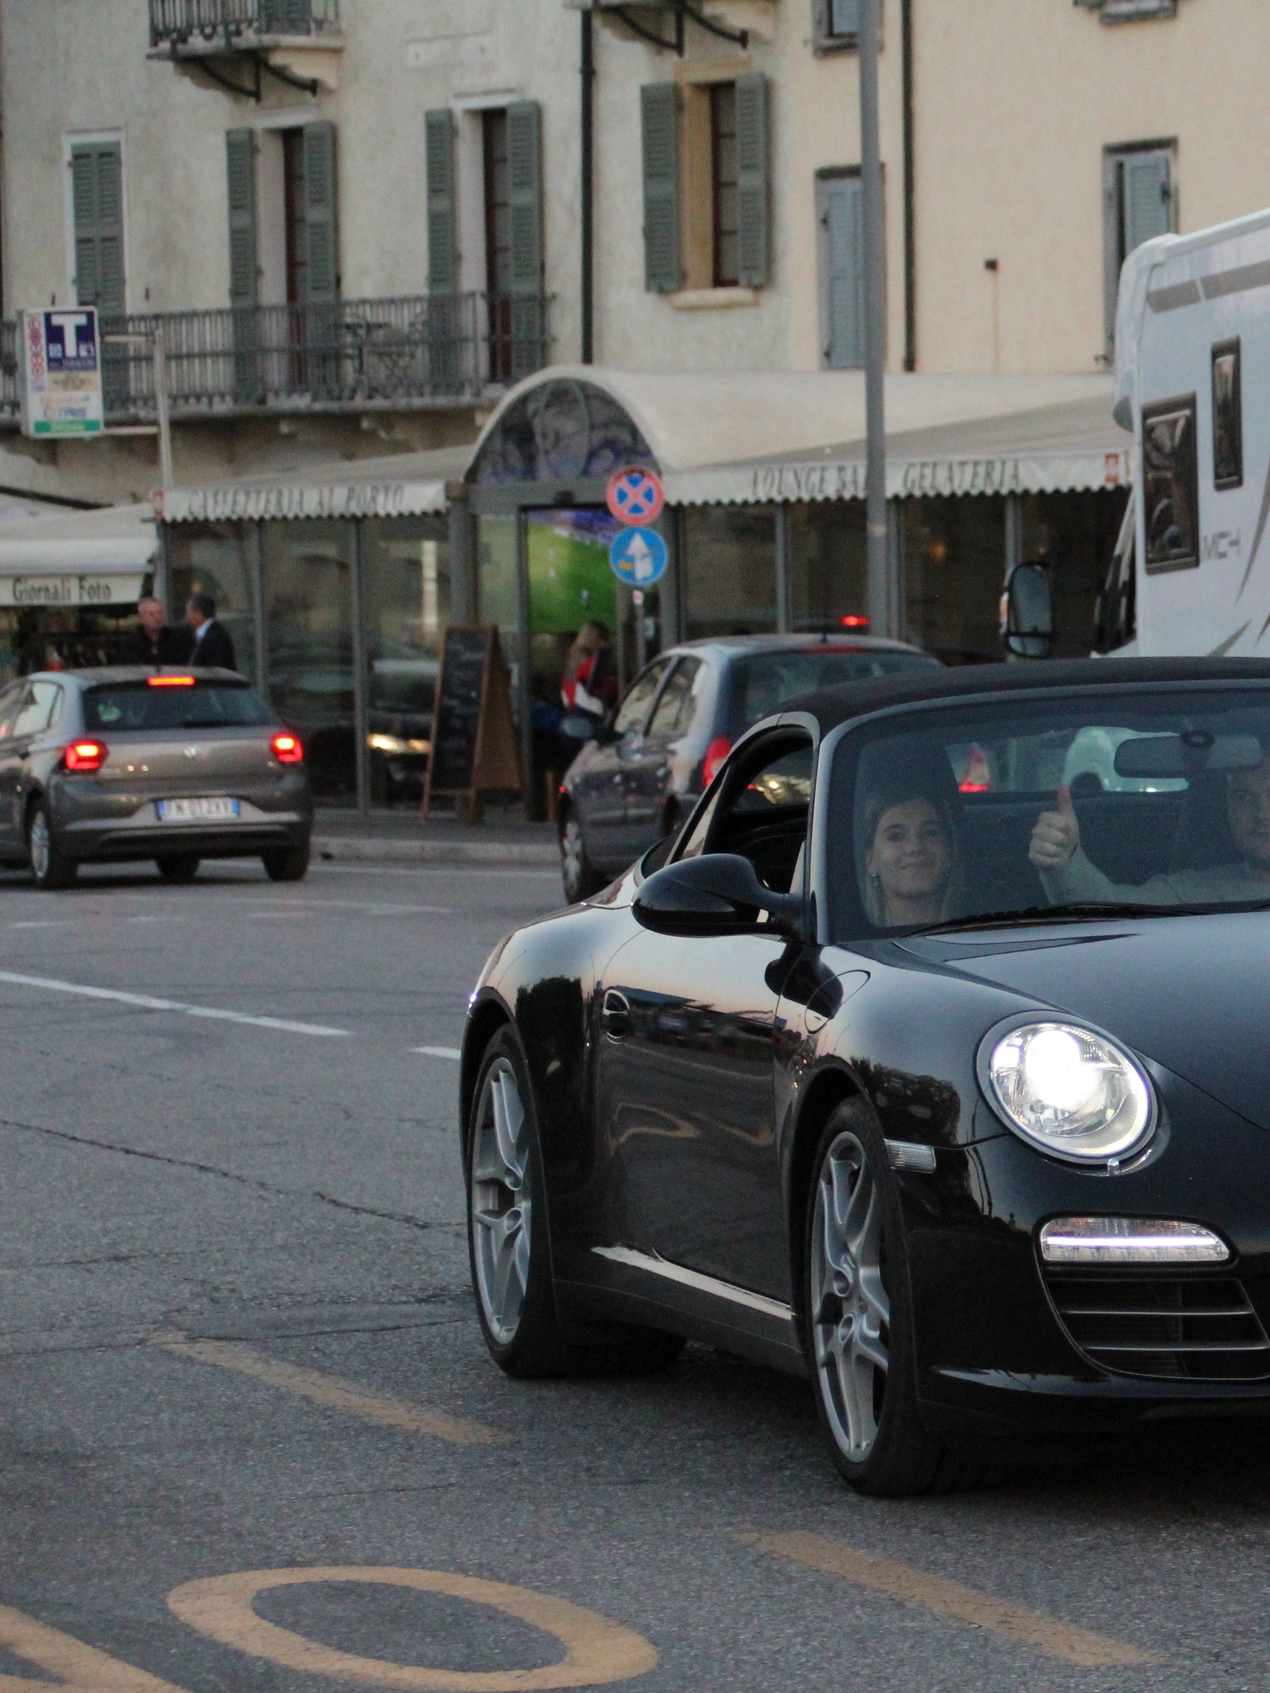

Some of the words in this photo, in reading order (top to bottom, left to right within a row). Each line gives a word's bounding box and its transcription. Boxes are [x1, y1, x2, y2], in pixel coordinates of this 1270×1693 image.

[51, 313, 87, 357] T
[751, 465, 827, 498] LOUNGE
[902, 459, 1022, 493] GELATERIA
[345, 483, 405, 513] PORTO
[12, 576, 72, 602] Giornali
[77, 575, 112, 601] Foto
